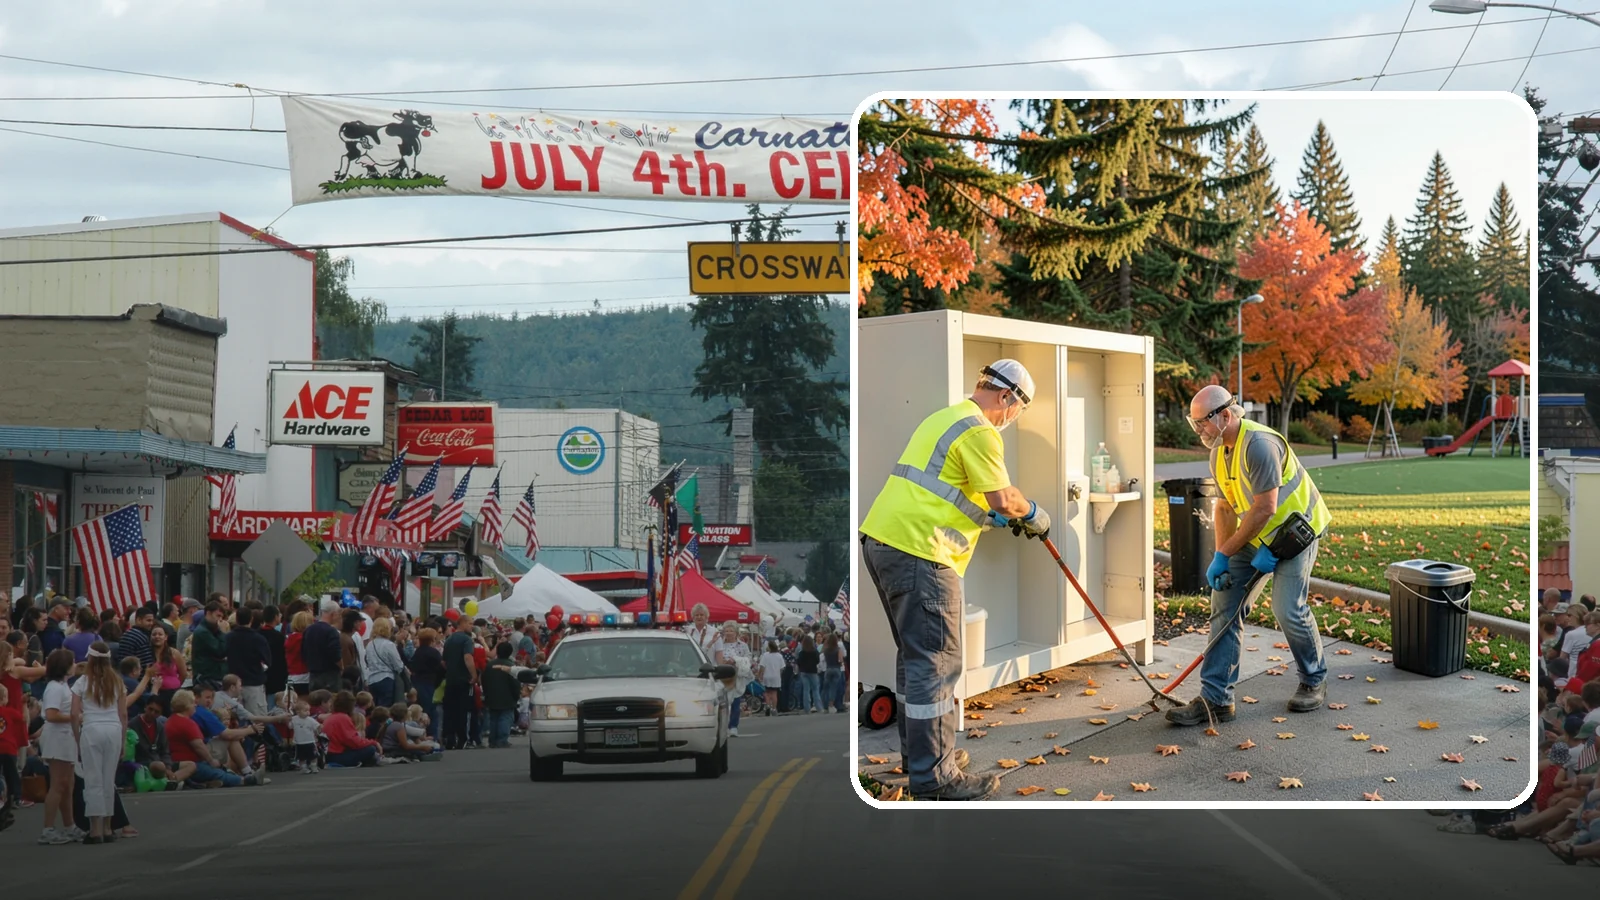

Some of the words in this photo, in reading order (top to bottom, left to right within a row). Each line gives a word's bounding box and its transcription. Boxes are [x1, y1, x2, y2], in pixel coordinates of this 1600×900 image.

[694, 121, 850, 150] Carnat
[481, 140, 605, 192] JULY
[632, 150, 746, 198] 4th.
[697, 254, 850, 280] CROSSWA
[283, 380, 373, 420] ACE
[405, 409, 453, 422] CEDAR
[283, 421, 371, 436] Hardware
[416, 427, 477, 447] Coca-Cola
[353, 467, 385, 479] Simpl
[83, 486, 93, 495] St.
[95, 485, 124, 495] Vincent
[126, 486, 135, 495] de
[137, 486, 155, 496] Paul
[212, 516, 330, 536] HARDARE
[688, 526, 741, 535] CRNATION
[699, 535, 730, 543] GLASS
